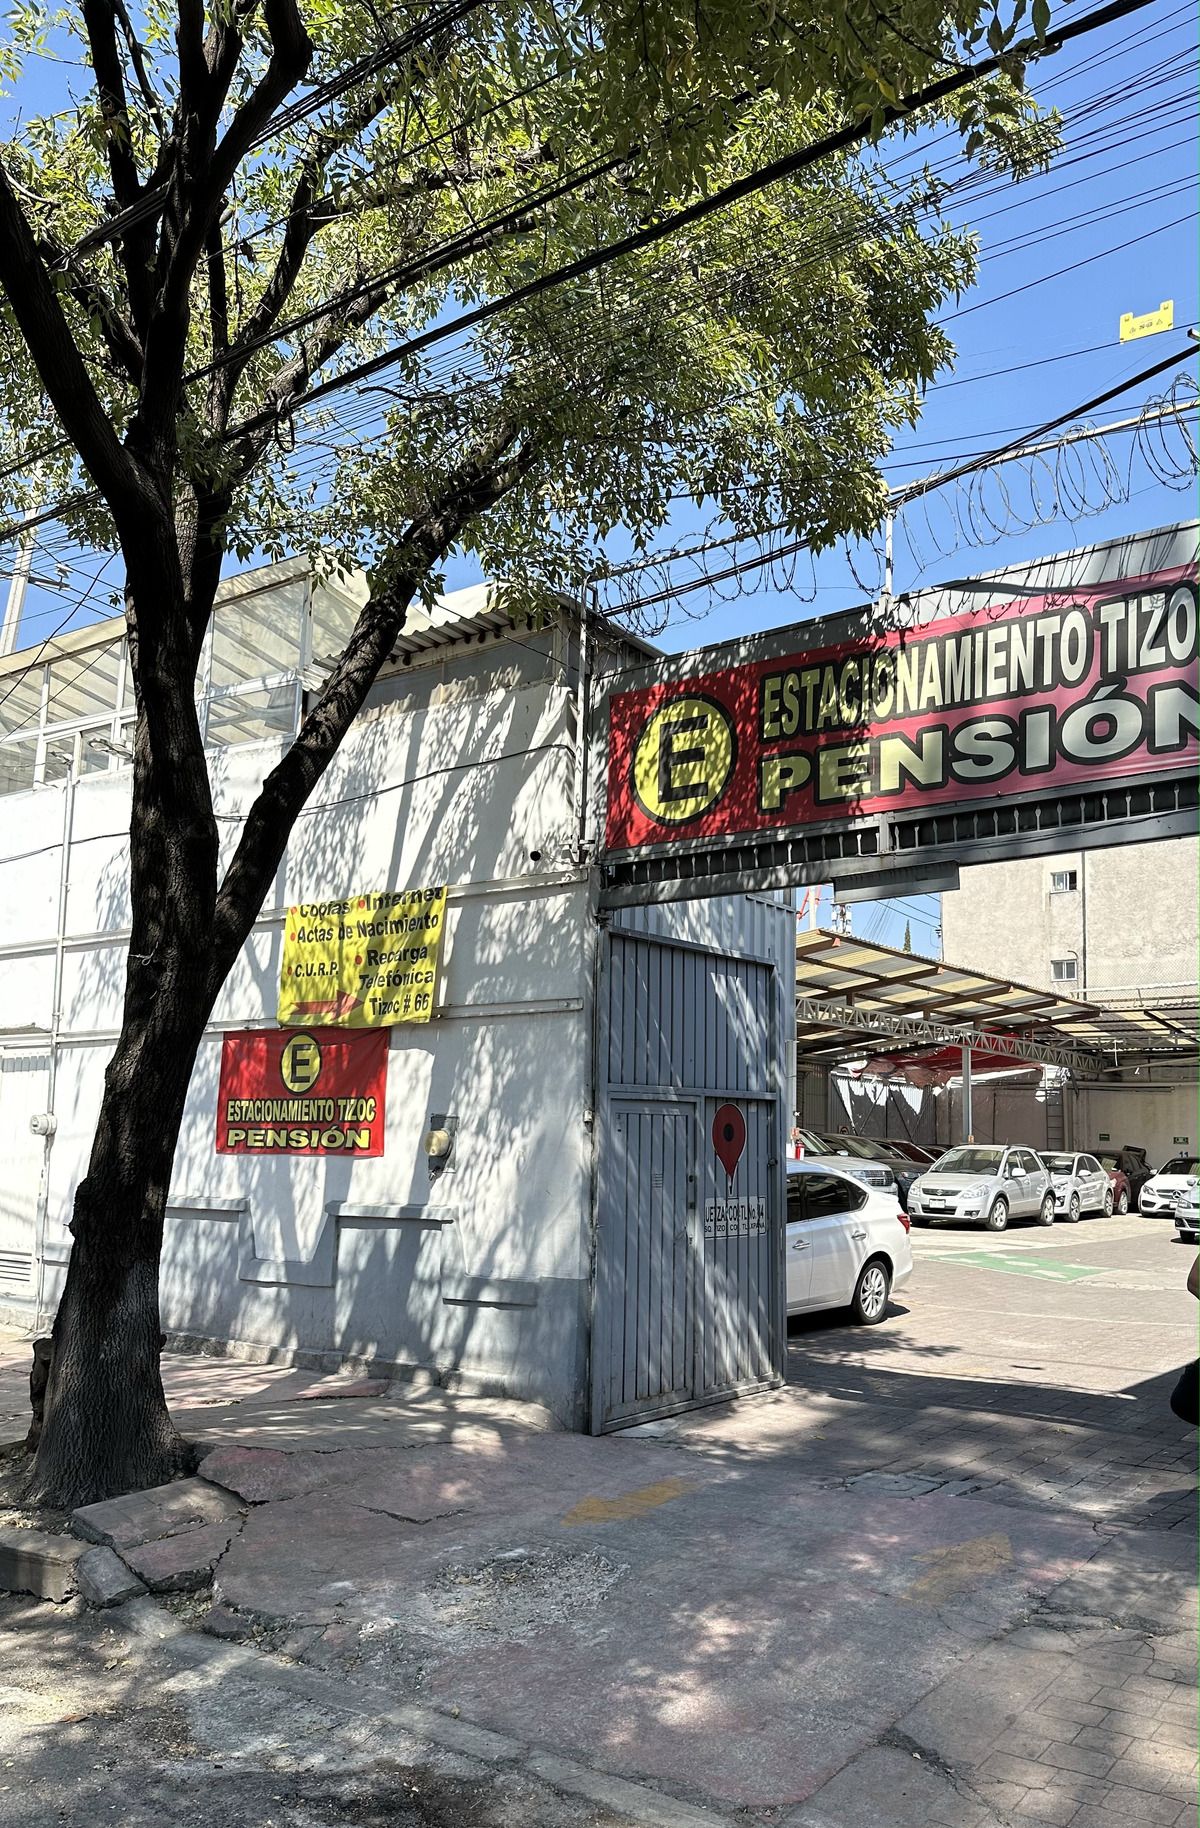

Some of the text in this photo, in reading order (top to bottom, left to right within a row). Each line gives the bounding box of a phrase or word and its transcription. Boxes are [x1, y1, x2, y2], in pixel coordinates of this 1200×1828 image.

[763, 610, 1088, 739] ESTACIONAMIENTO
[658, 712, 709, 804] E
[760, 684, 1199, 809] PENSIÓN
[300, 887, 443, 921] Copias Internet
[297, 913, 439, 944] Actas de Nacimiento
[367, 946, 428, 966] Recarga
[359, 969, 434, 990] Telefónica
[369, 993, 430, 1016] Tizoc # 66
[290, 1043, 313, 1083] E
[227, 1098, 376, 1123] ESTACIONAMIENTO TIZOC
[226, 1126, 371, 1149] PENSIÓN
